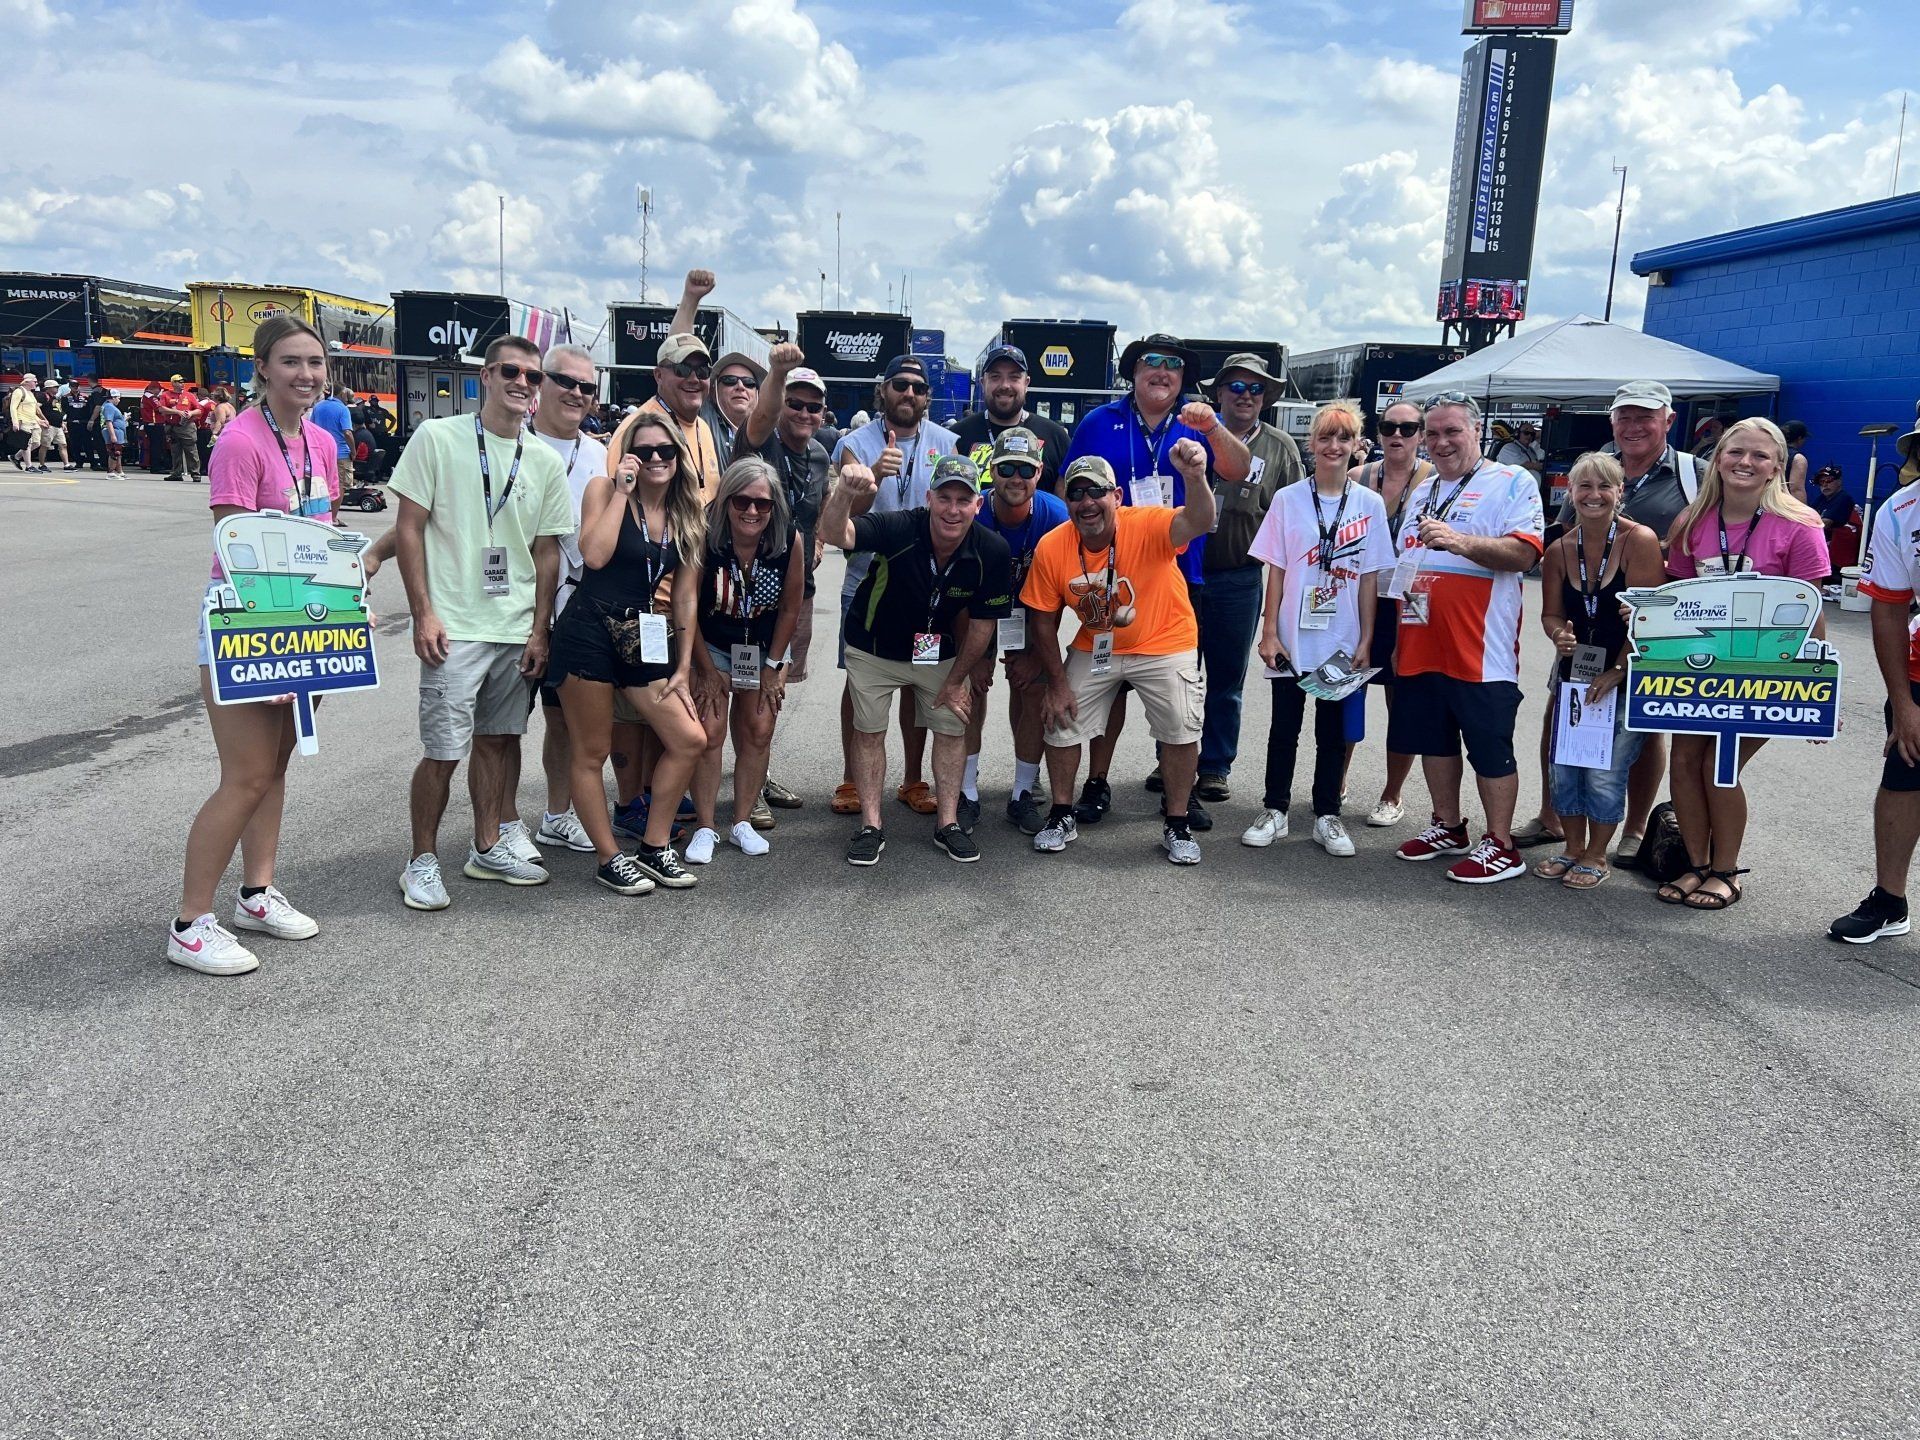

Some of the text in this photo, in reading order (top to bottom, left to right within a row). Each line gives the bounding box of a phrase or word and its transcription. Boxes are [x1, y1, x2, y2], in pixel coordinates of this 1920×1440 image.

[1511, 51, 1517, 63] 1
[1508, 65, 1515, 77] 2
[1507, 79, 1514, 90] 3
[1505, 92, 1512, 104] 4
[1504, 106, 1511, 118] 5
[1502, 120, 1509, 131] 6
[1501, 133, 1508, 145] 7
[1499, 147, 1506, 158] 8
[1476, 91, 1500, 232] MISPEEDWAY.com
[1498, 161, 1505, 172] 9
[1494, 174, 1507, 186] 10
[1493, 188, 1505, 199] 11
[1491, 201, 1504, 212] 12
[1490, 214, 1502, 225] 13
[1488, 227, 1500, 238] 14
[1487, 241, 1499, 252] 15
[7, 289, 77, 300] MENARDS
[343, 319, 384, 347] TEAM
[650, 321, 707, 335] LIBTY
[428, 320, 479, 352] ally
[825, 330, 884, 349] Hendrick
[836, 344, 880, 355] cars.com
[1045, 353, 1069, 368] NAPA
[407, 390, 427, 402] ally
[1295, 414, 1311, 426] GEICO
[1339, 511, 1363, 528] HASE
[295, 544, 311, 553] MIS
[293, 552, 329, 562] CAMPING
[484, 568, 508, 576] GARAGE
[1677, 600, 1701, 610] MIS
[1673, 608, 1728, 618] CAMPING
[217, 627, 367, 661] MIS CAMPING
[230, 655, 367, 684] GARAGE TOUR
[733, 663, 758, 671] GARAGE
[1574, 663, 1602, 673] GARAGE
[1634, 675, 1833, 702] MIS CAMPING
[1642, 701, 1821, 723] GARAGE TOUR
